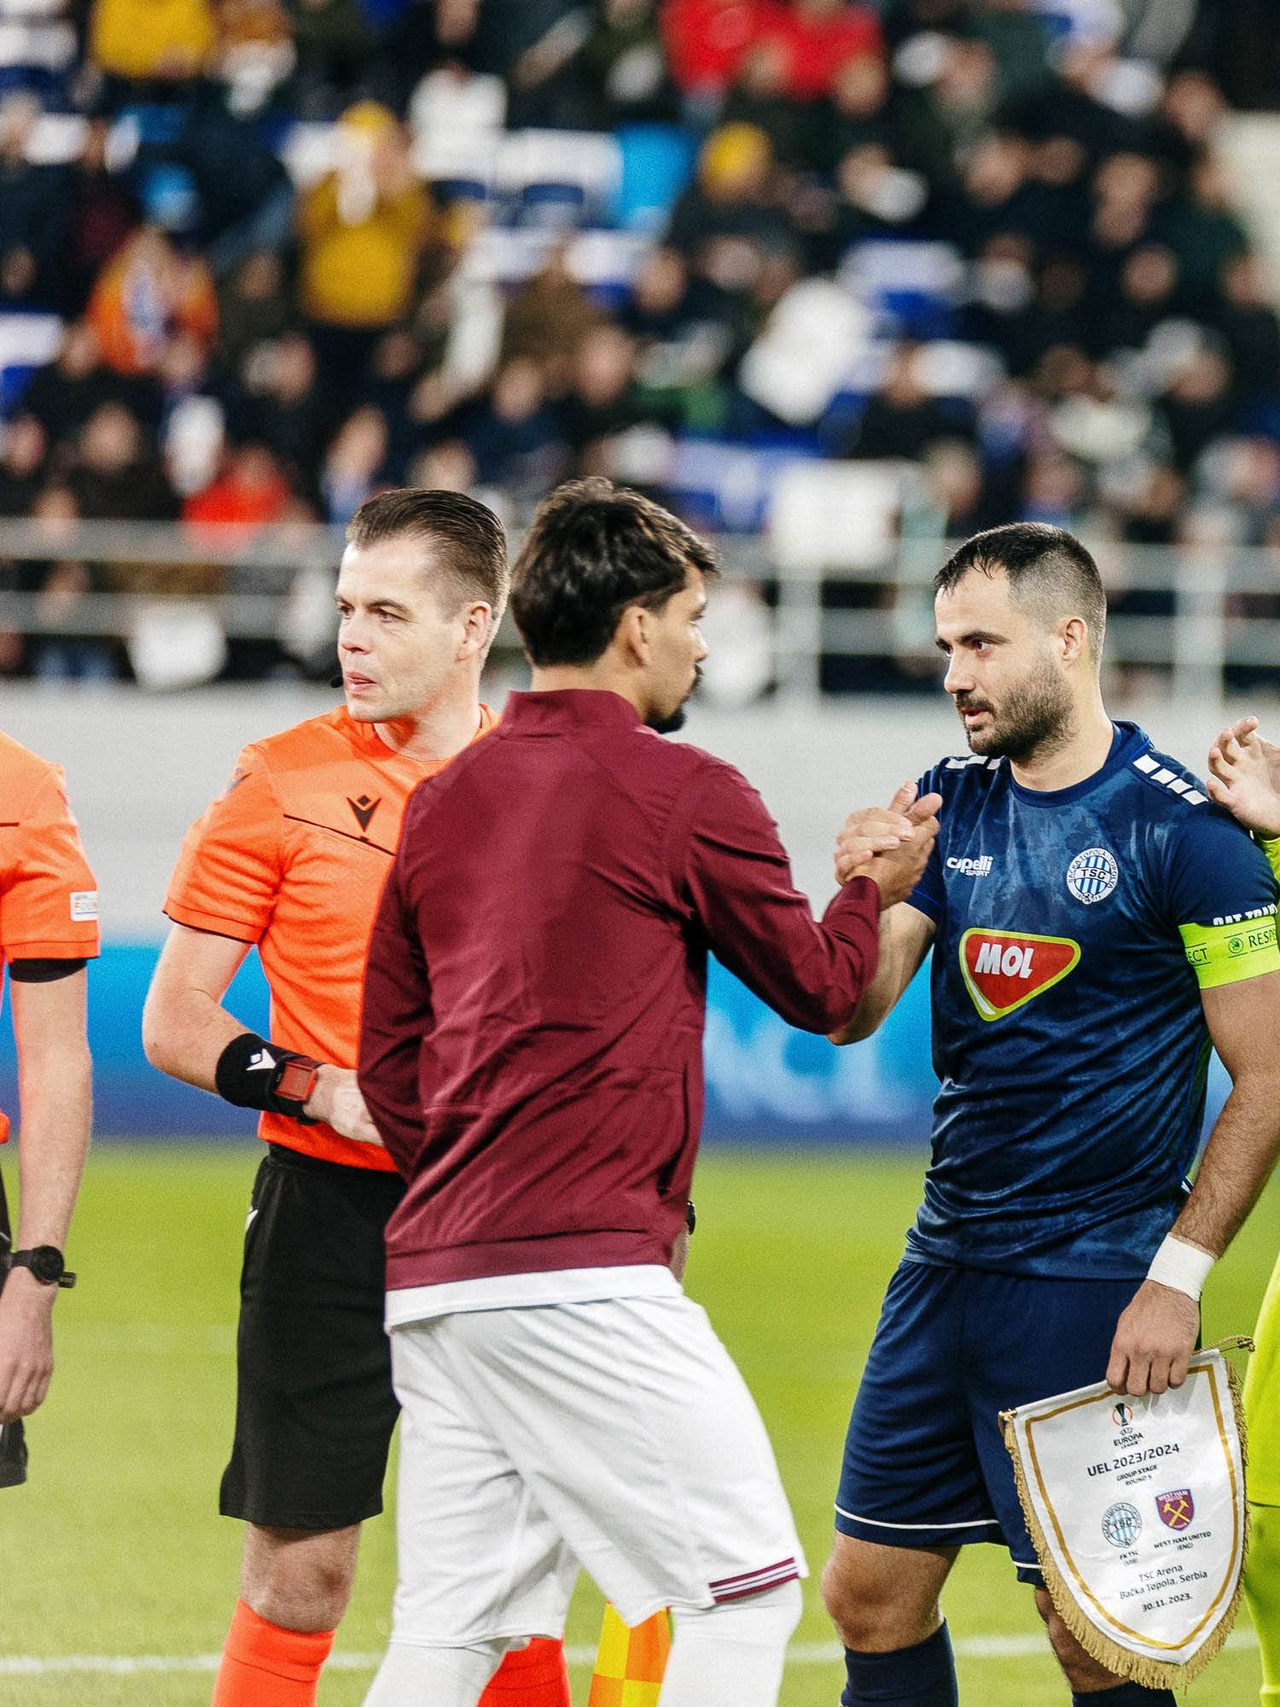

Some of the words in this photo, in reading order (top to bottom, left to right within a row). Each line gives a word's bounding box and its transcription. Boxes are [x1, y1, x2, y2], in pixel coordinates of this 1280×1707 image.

[1081, 869, 1107, 880] TSC
[974, 942, 1035, 979] MOL
[1113, 1432, 1144, 1446] EUROPA
[1087, 1462, 1112, 1477] UEL
[1113, 1443, 1180, 1469] 2023/2024
[1116, 1470, 1137, 1482] GROUP
[1138, 1464, 1158, 1474] STAGE
[1153, 1539, 1171, 1549] WEST
[1172, 1535, 1188, 1544] HAM
[1188, 1531, 1212, 1541] UNITED
[1139, 1571, 1155, 1582] TSC
[1156, 1564, 1183, 1577] Arena
[1179, 1570, 1208, 1583] Serbia
